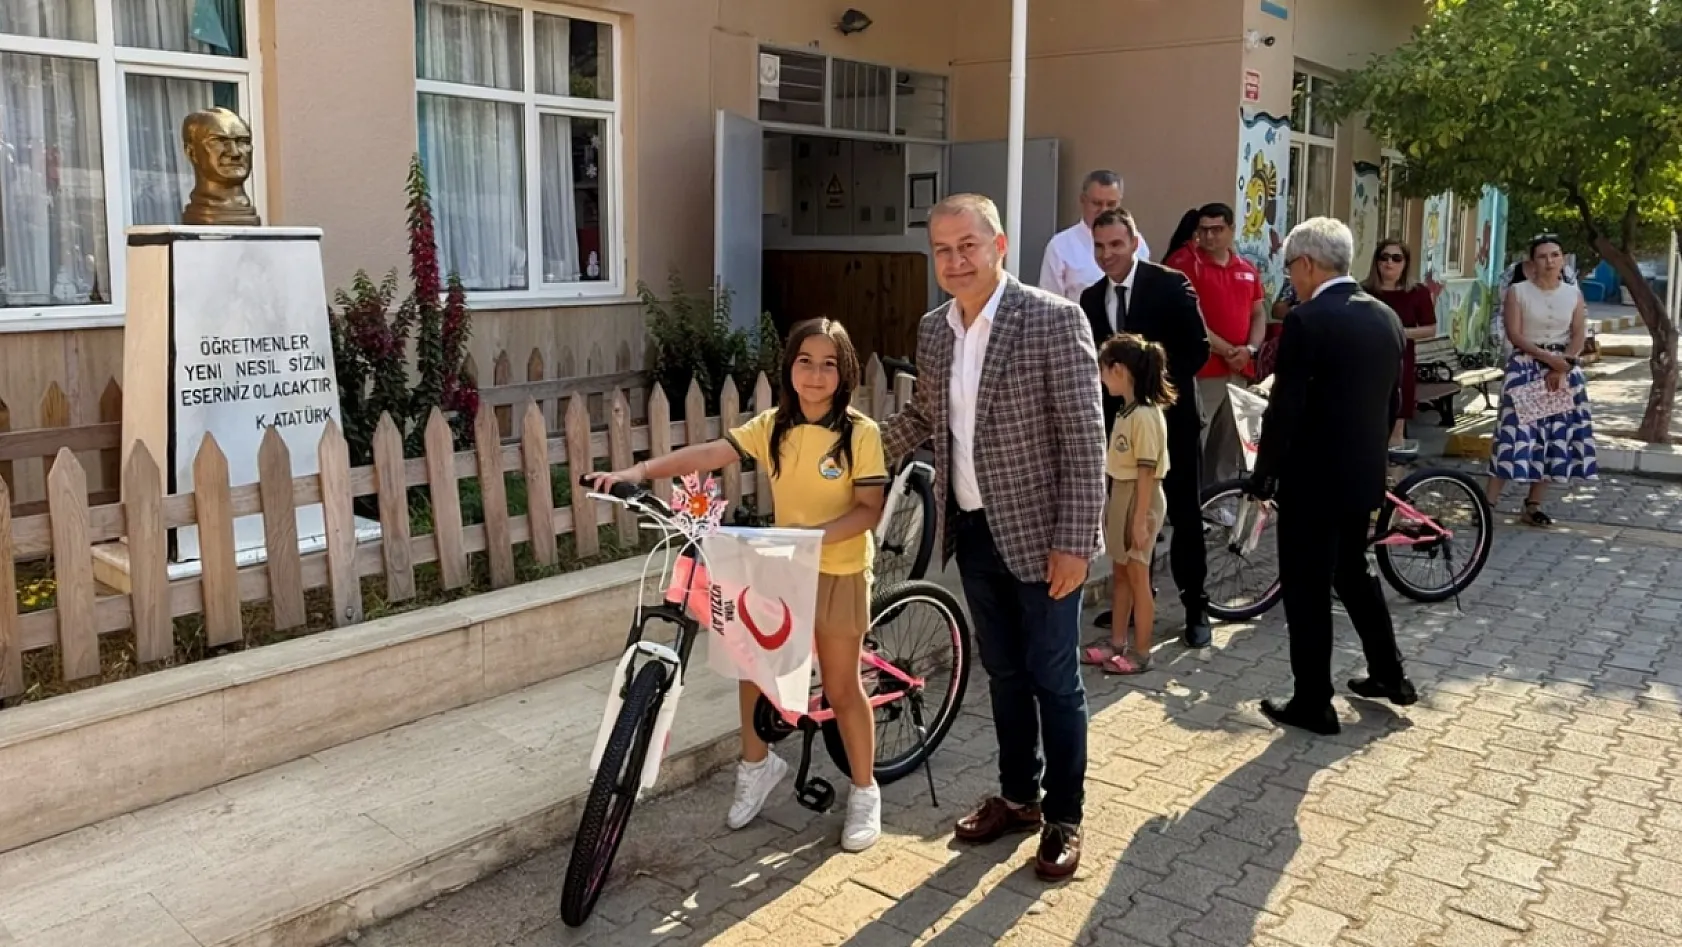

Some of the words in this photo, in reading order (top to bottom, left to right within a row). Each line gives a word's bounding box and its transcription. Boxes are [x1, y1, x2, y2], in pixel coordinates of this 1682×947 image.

[200, 334, 309, 356] ÖĞRETMENLER
[181, 380, 250, 406] ESERİNİZ
[252, 376, 332, 399] OLACAKTIR
[273, 405, 332, 428] ATATÜRK
